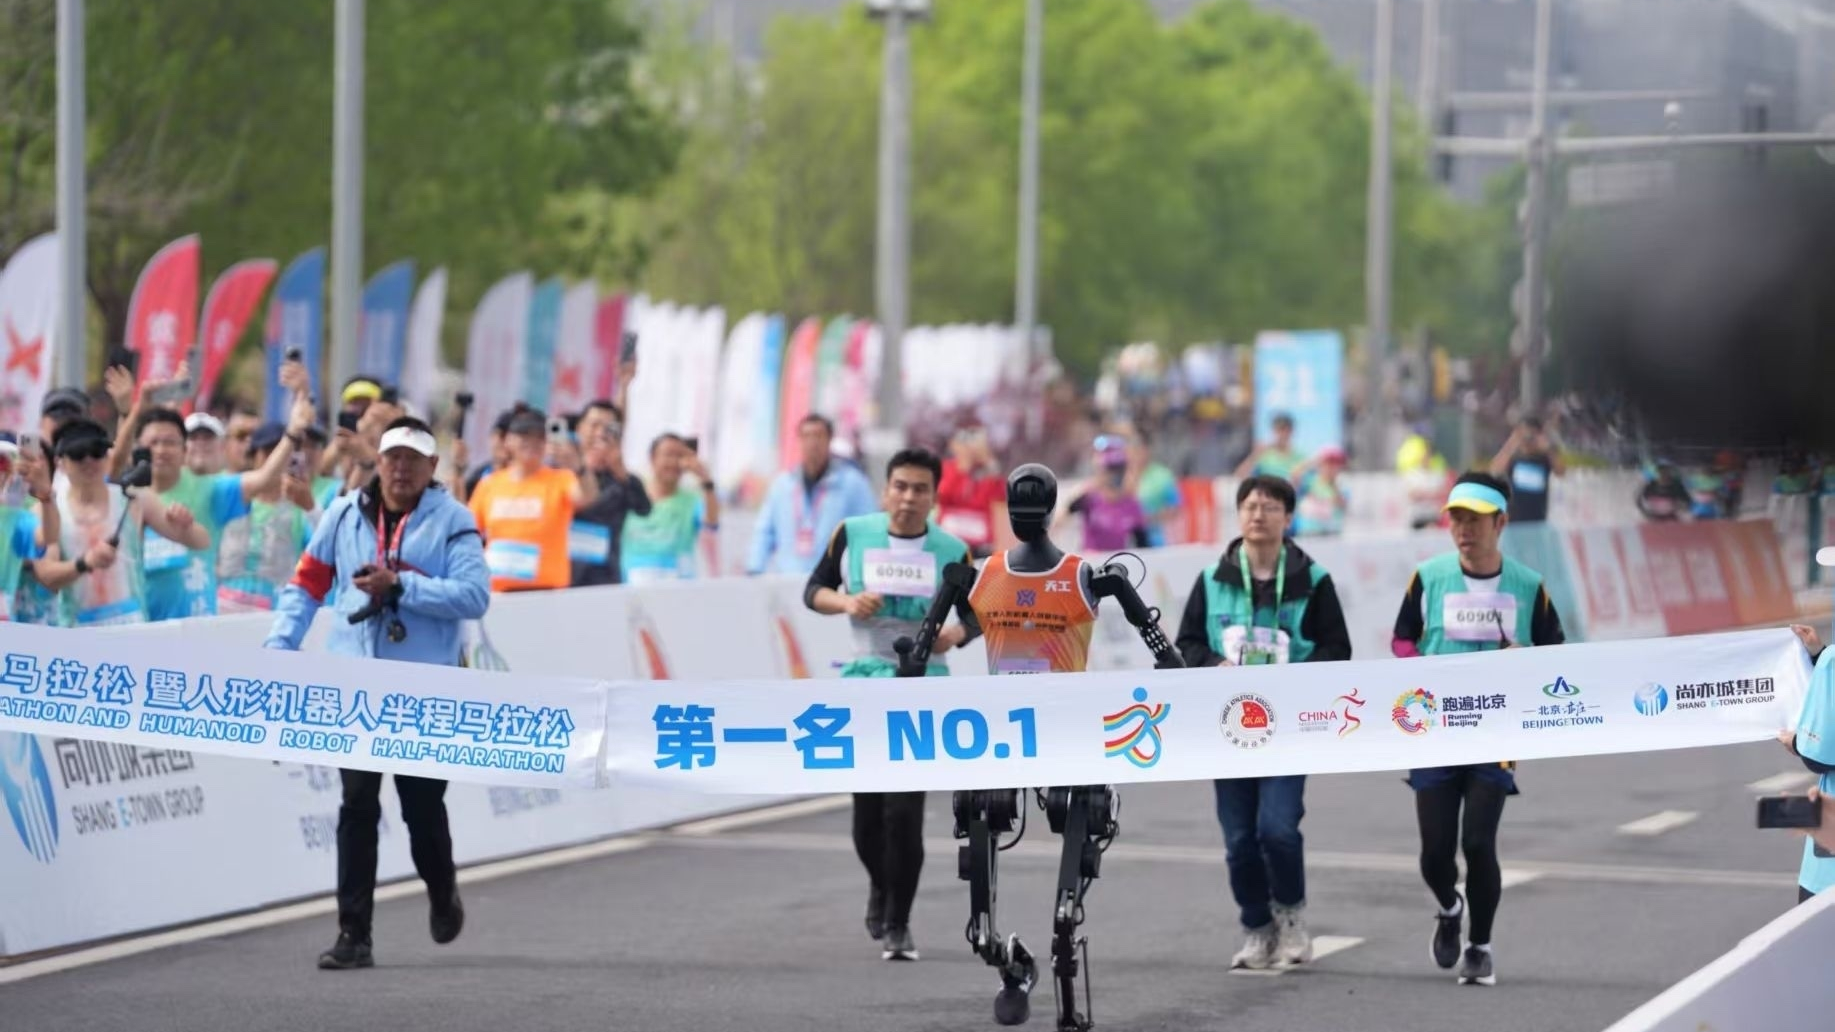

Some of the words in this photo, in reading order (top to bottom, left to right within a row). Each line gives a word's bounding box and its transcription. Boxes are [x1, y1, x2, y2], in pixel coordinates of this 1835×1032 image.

[876, 565, 923, 579] 60901
[1676, 677, 1775, 701] 尚亦城集团
[0, 653, 136, 704] 马拉松
[144, 669, 575, 748] 暨人形机器人半程马拉松
[1442, 694, 1506, 712] 跑遍北京
[1676, 701, 1707, 710] SHANG
[1711, 698, 1744, 708] E-TOWN
[1745, 695, 1775, 704] GROUP
[1298, 710, 1338, 722] CHINA
[1448, 713, 1483, 721] Running
[1448, 719, 1479, 728] Beijing
[1522, 716, 1603, 729] BEIJINGETOWN
[78, 707, 130, 729] AND
[140, 713, 267, 743] HUMANOID
[280, 728, 357, 753] ROBOT
[371, 738, 565, 773] HALF-MARATHON
[652, 703, 854, 770] 第一名
[887, 708, 1038, 761] NO.1
[72, 800, 118, 834] SHANG
[164, 784, 204, 819] GROUP
